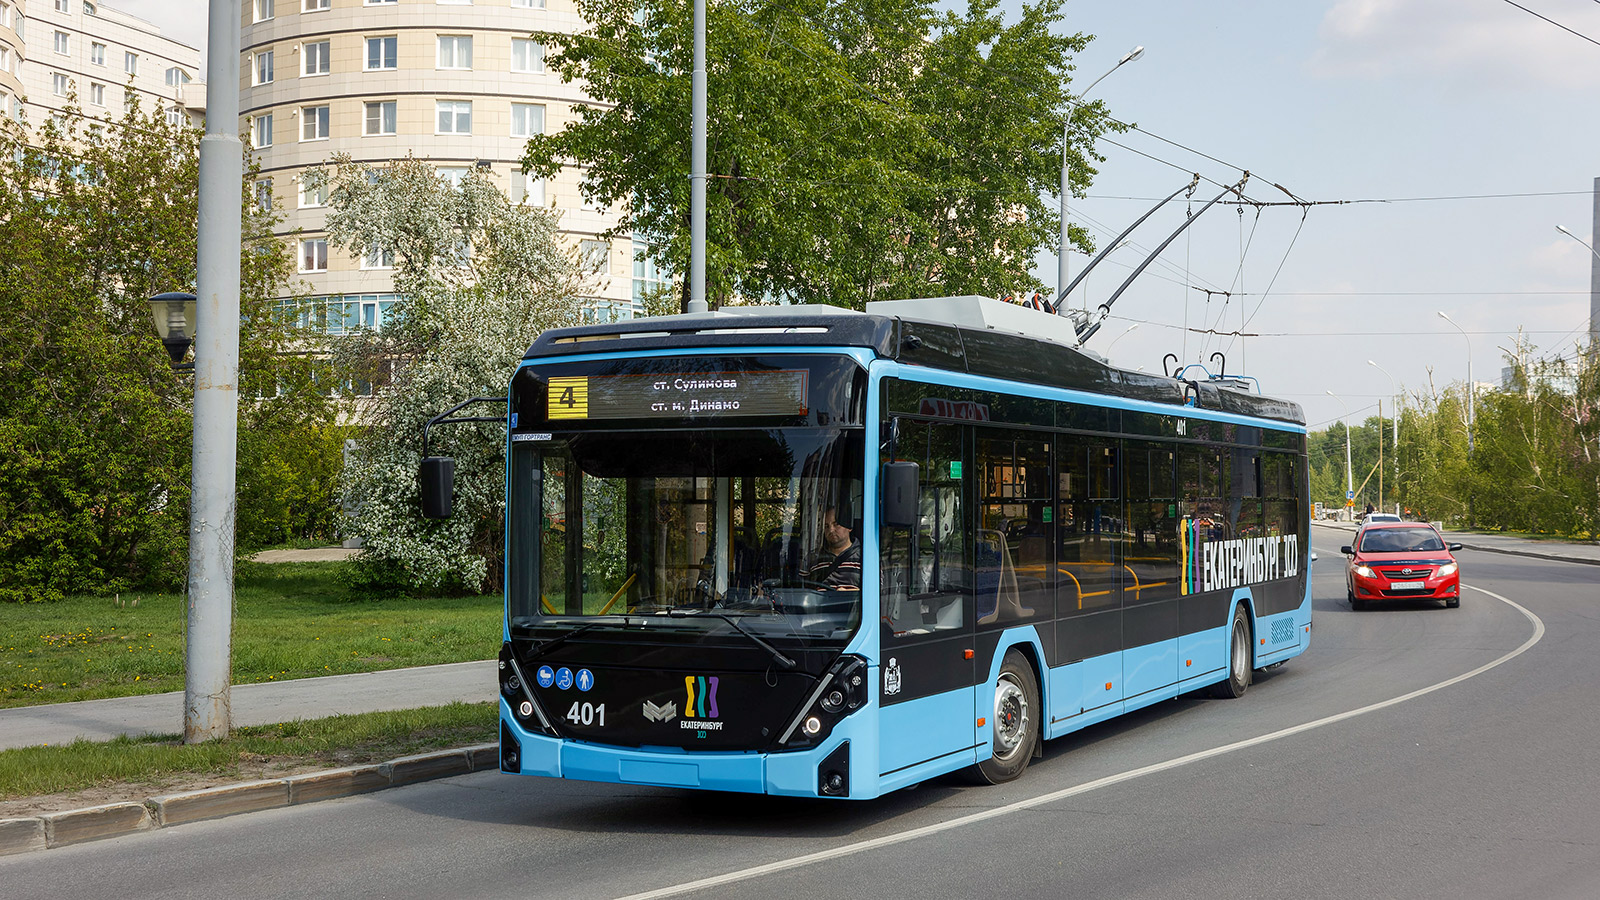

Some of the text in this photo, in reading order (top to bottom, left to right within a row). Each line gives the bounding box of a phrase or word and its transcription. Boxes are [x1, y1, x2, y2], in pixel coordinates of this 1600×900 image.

[653, 379, 737, 392] ст. Сулимова
[560, 387, 576, 408] 4
[651, 403, 668, 411] ст.
[689, 400, 740, 412] Динамо
[1176, 419, 1186, 436] 401
[1203, 535, 1281, 592] ЕКАТЕРИНБУРГ
[566, 701, 605, 727] 401
[680, 720, 723, 730] ЕКАТЕРИНБУРГ
